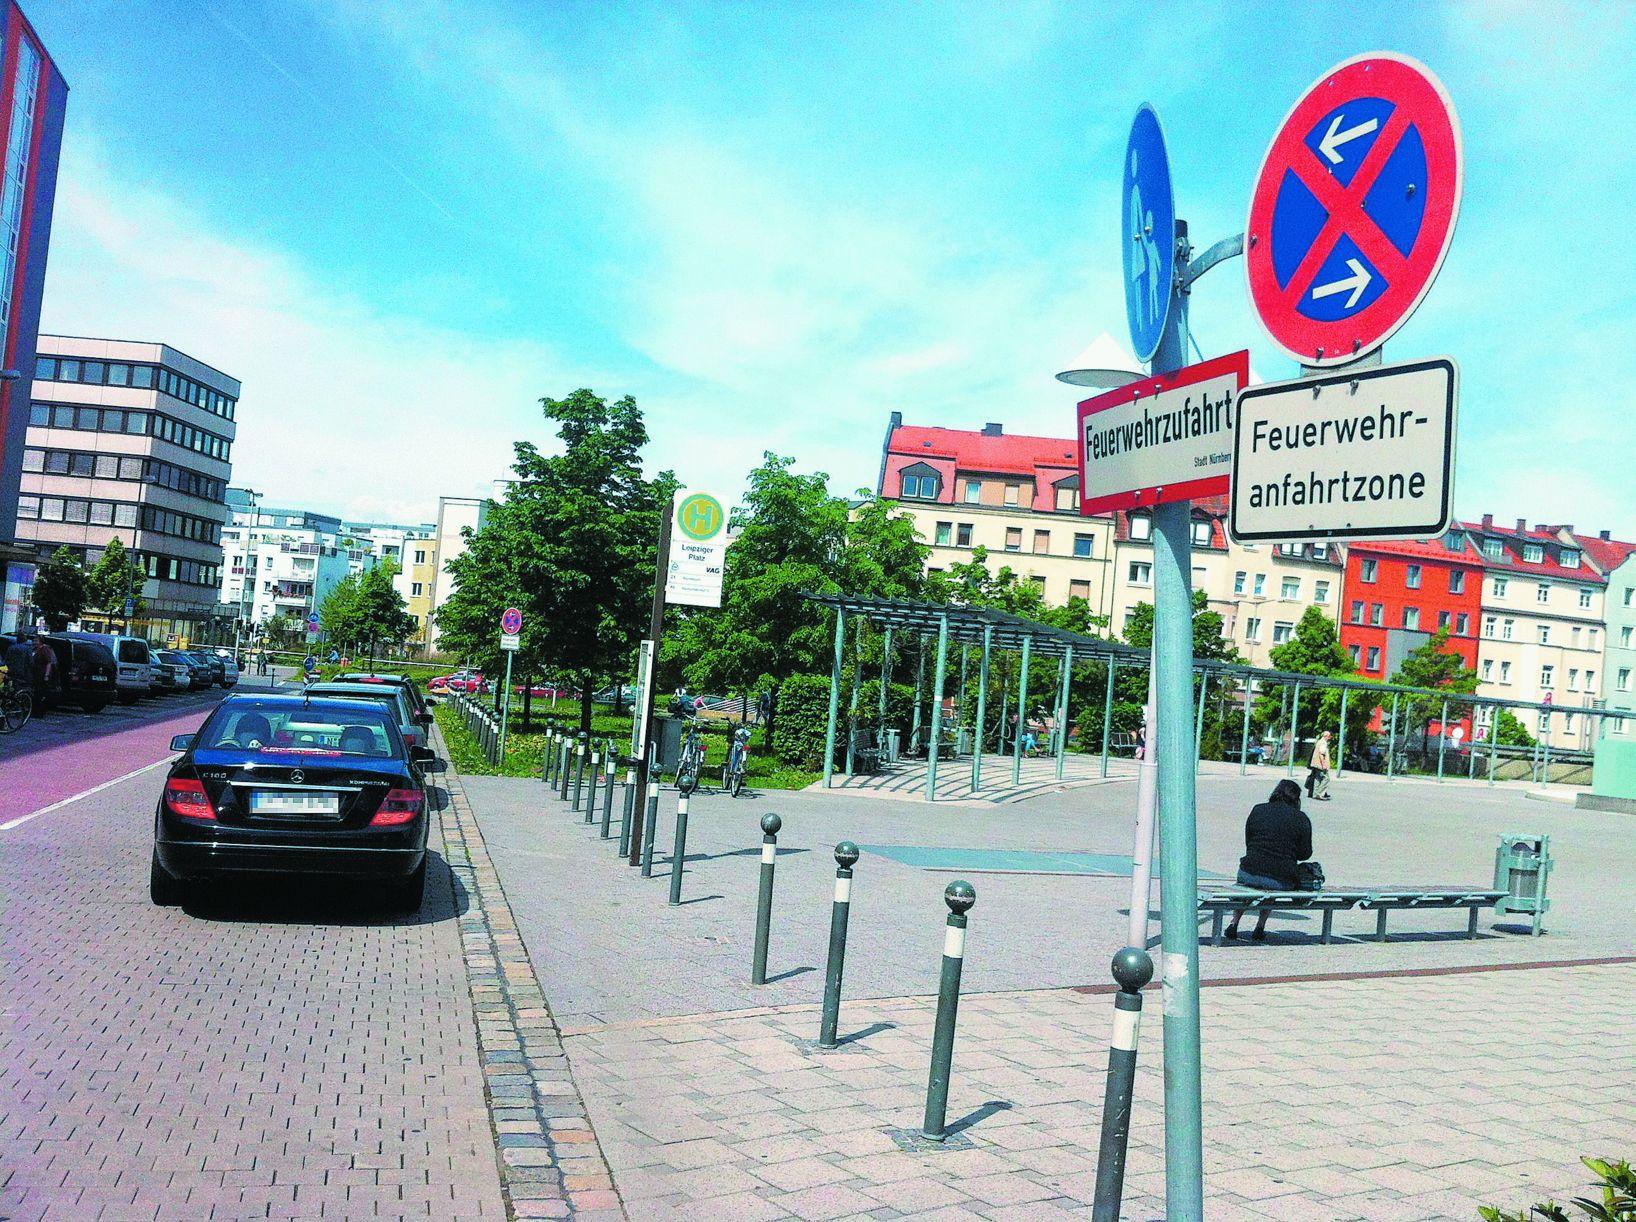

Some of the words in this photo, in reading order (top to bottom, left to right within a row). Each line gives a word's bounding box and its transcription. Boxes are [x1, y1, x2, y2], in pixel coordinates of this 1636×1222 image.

[1085, 390, 1232, 462] Feuerwehrzufahrt
[1252, 404, 1428, 453] Feuerwehr-
[1194, 455, 1208, 467] Stadt
[1249, 470, 1426, 508] anfahrtzone
[690, 504, 713, 531] H
[681, 543, 714, 555] Leipziger
[688, 553, 706, 562] Platz
[706, 566, 720, 574] VAG
